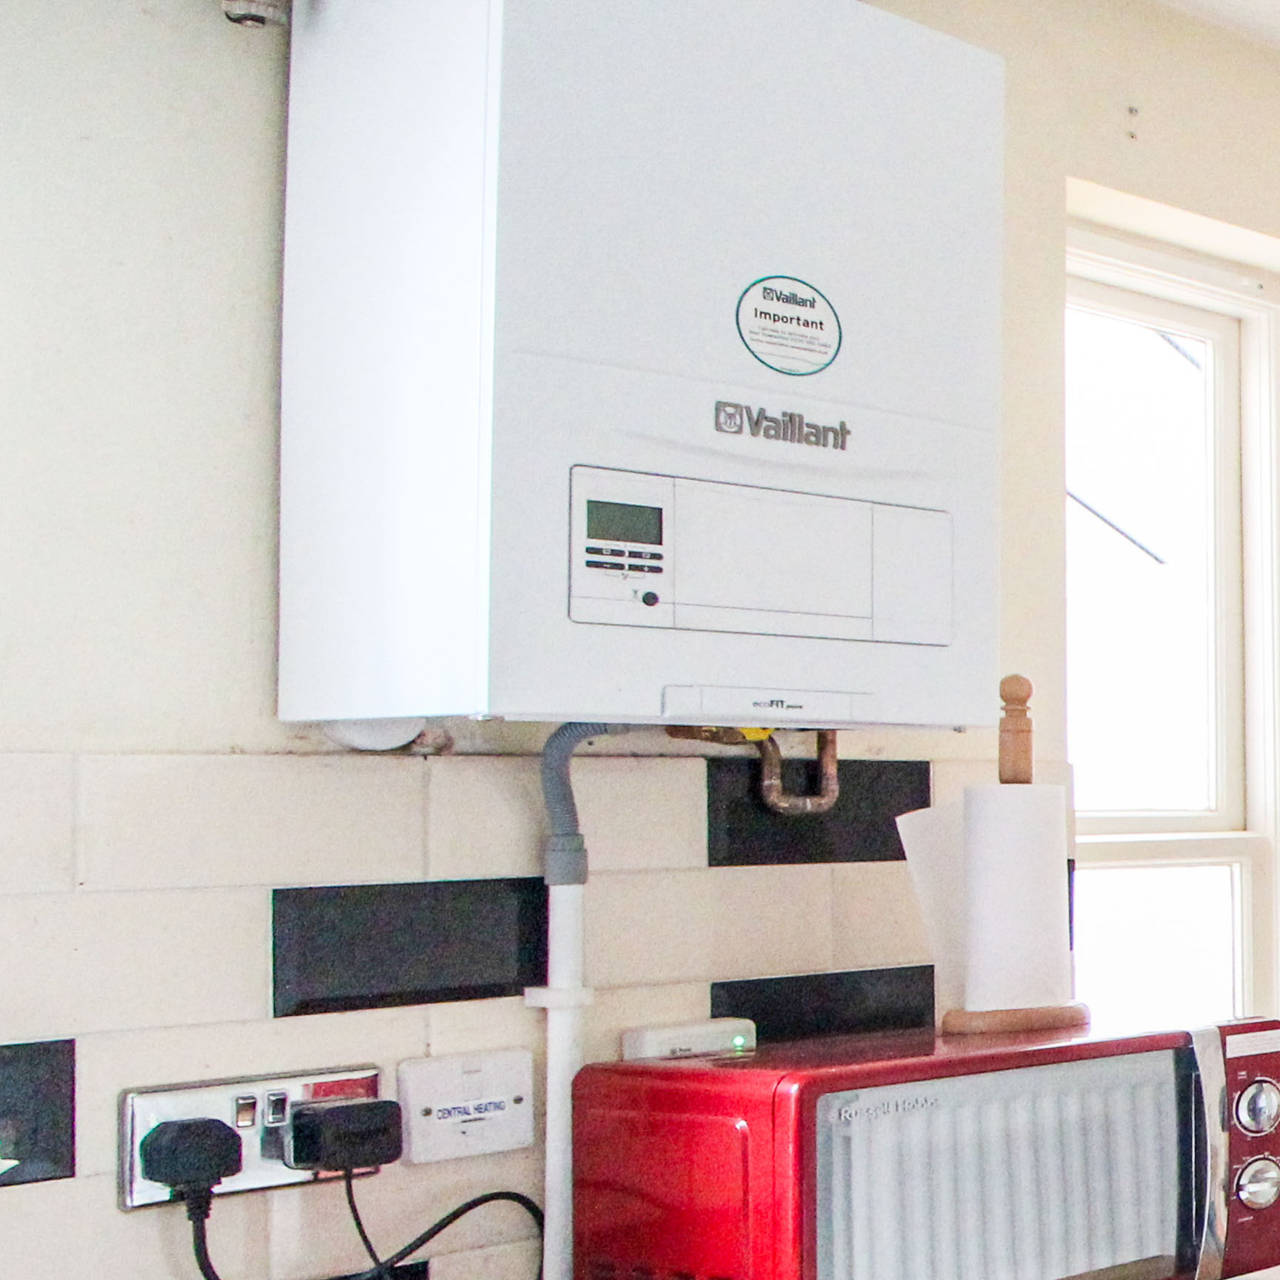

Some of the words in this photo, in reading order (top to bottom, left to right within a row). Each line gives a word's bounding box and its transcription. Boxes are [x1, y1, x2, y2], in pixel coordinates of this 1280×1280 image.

[775, 289, 817, 309] Vaillant
[754, 307, 825, 331] Important
[744, 405, 852, 450] Vaillant
[437, 1106, 471, 1120] CENTRAL
[473, 1101, 506, 1114] HEATING
